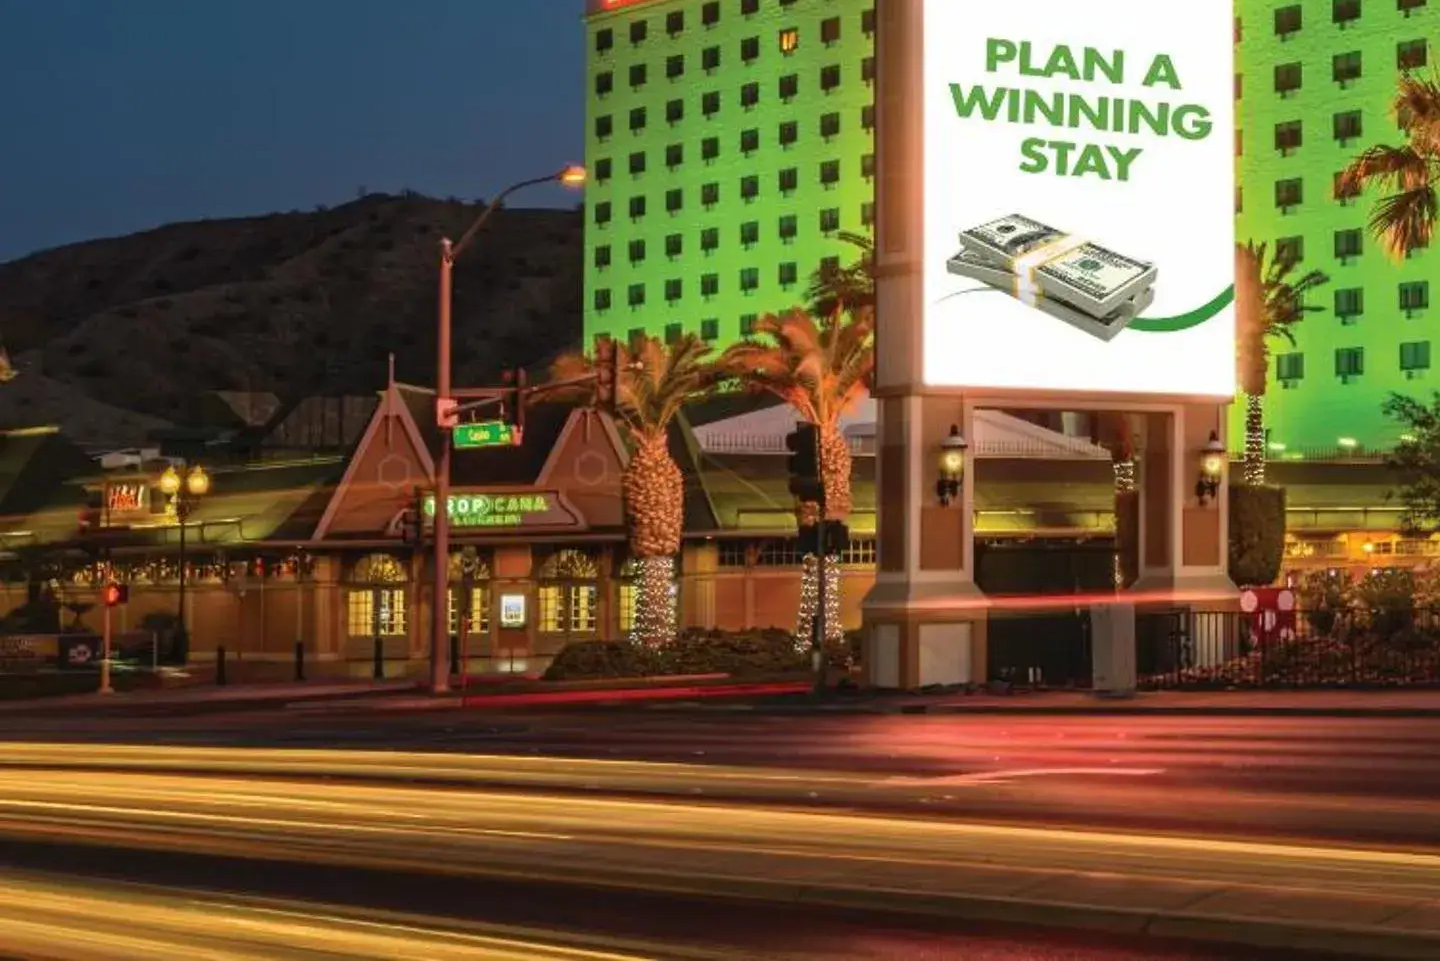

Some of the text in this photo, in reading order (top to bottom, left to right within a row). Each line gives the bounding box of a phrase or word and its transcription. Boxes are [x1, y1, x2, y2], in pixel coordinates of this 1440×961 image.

[985, 37, 1182, 90] PLAN A
[948, 82, 1213, 141] WINNING
[1018, 137, 1144, 182] STAY
